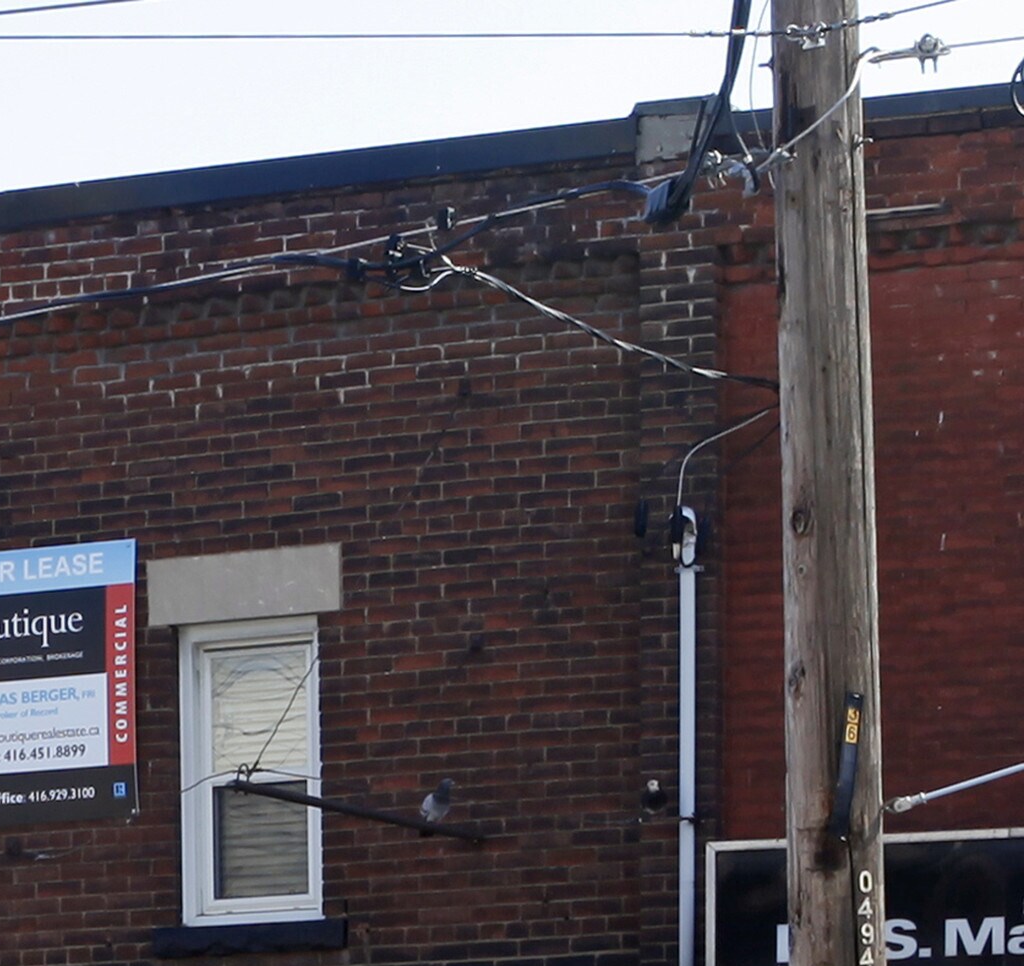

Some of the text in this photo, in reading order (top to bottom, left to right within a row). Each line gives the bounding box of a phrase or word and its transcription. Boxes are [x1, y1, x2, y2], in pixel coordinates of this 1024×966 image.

[23, 552, 104, 581] LEASE
[114, 604, 128, 743] COMMERCIAL
[3, 744, 86, 762] 416.451.8899
[28, 786, 96, 803] 416.929.3100
